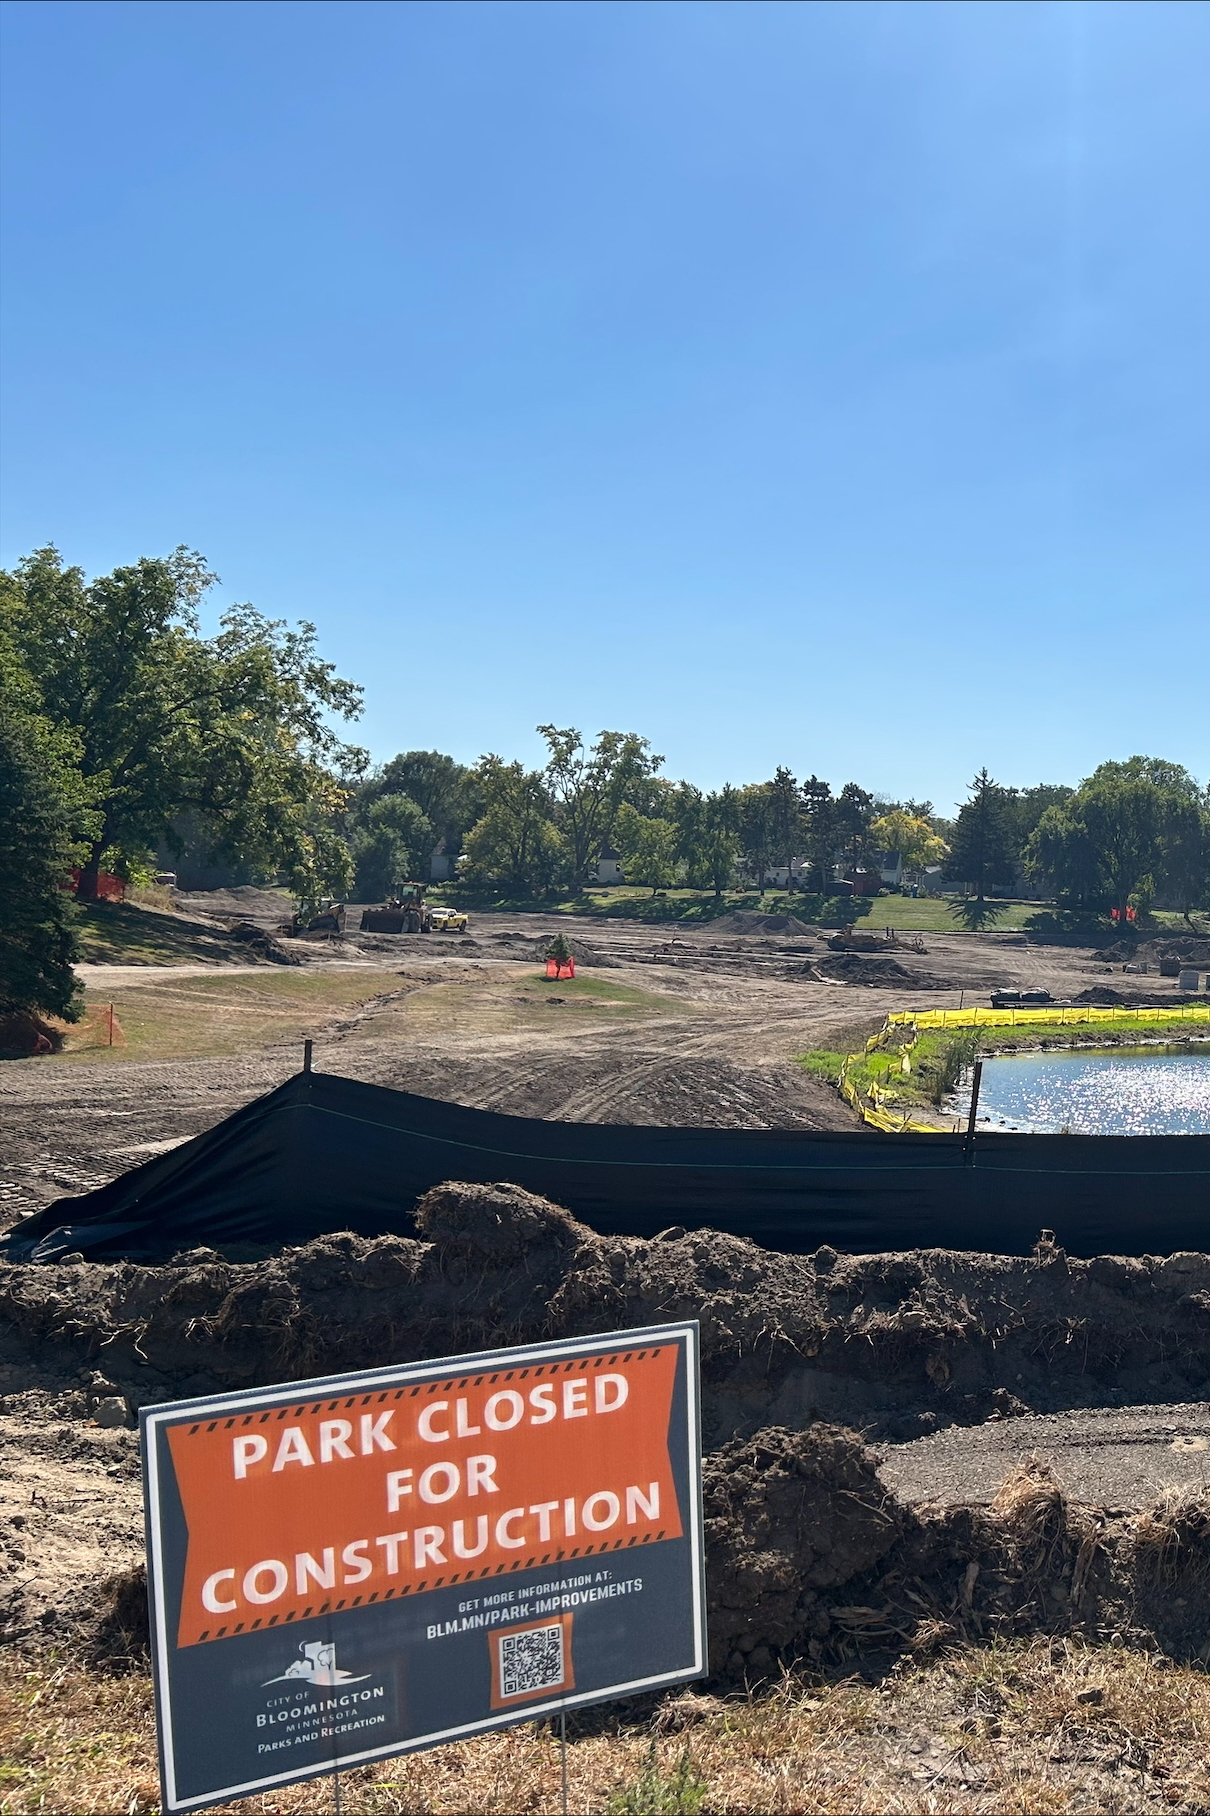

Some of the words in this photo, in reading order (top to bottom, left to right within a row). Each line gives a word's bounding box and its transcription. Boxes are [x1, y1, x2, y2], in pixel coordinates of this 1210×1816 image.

[232, 1410, 397, 1480] PARK
[417, 1373, 630, 1444] CLOSED
[386, 1454, 500, 1513] FOR
[200, 1481, 660, 1615] CONSTRUCTION
[426, 1578, 643, 1640] BLM.MN/PARK-IMPROVEMENTS
[458, 1599, 480, 1613] GET
[483, 1590, 515, 1606] MORE
[518, 1573, 592, 1599] INFORMATION
[595, 1570, 613, 1582] AT:
[256, 1686, 384, 1728] BLOOMINGTON
[266, 1695, 290, 1708] CITY
[295, 1691, 310, 1701] OF
[285, 1708, 358, 1732] MINNESOTA
[257, 1739, 292, 1754] PARKS
[294, 1732, 318, 1745] AND
[320, 1714, 385, 1738] RECREATION
